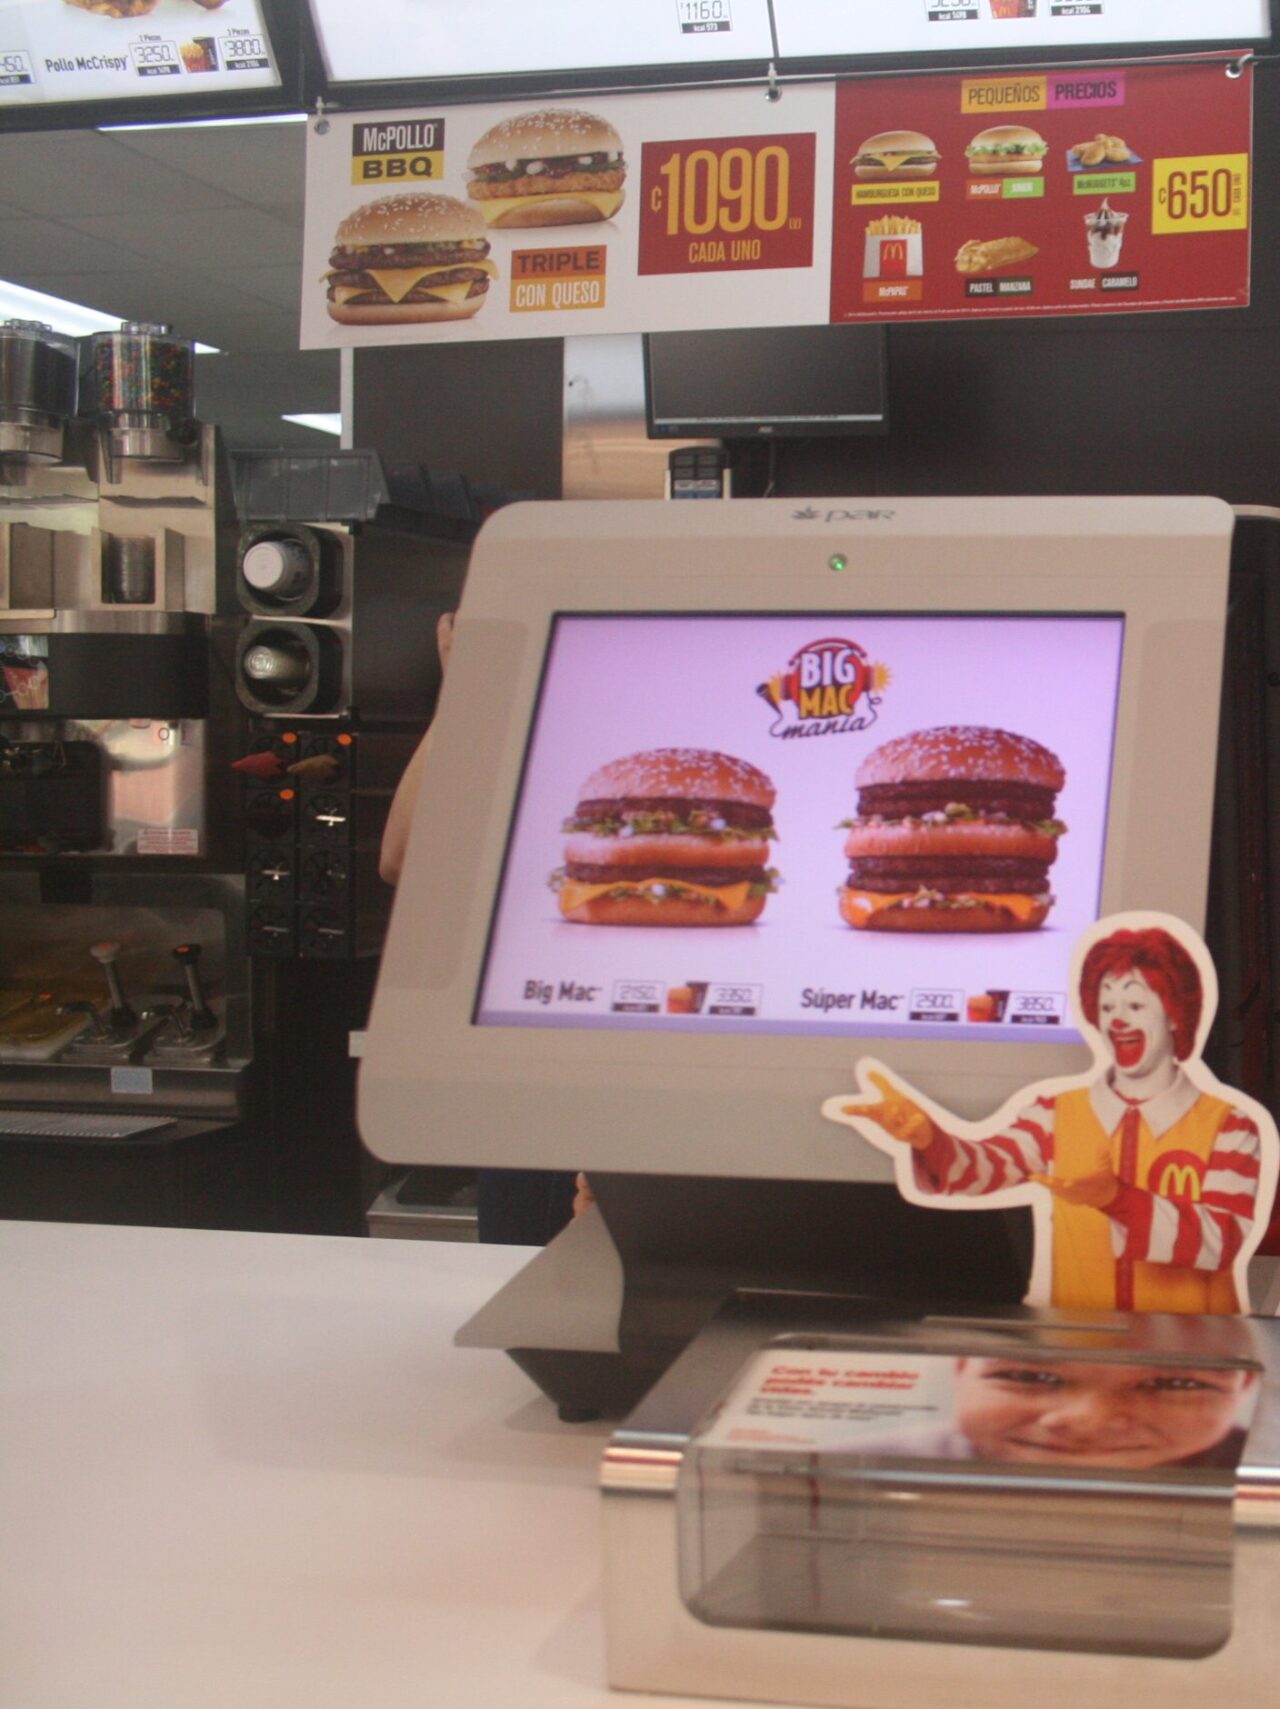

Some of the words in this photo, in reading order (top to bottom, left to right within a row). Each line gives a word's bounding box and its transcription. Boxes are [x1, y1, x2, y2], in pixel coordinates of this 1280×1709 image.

[45, 58, 75, 73] Pollo
[77, 56, 127, 71] McCrispy
[968, 84, 1041, 105] PEQUEÑOS
[1055, 81, 1117, 101] PRECIOS
[363, 123, 435, 152] McPOLLO
[363, 156, 433, 179] BBQ
[517, 250, 600, 273] TRIPLE
[688, 241, 726, 263] CADA
[731, 238, 761, 261] UNO
[515, 283, 547, 307] CON
[551, 280, 600, 308] QUESO
[969, 282, 994, 293] PASTEL
[801, 649, 856, 688] BIG
[801, 684, 854, 718] MAC
[781, 714, 868, 740] mania
[523, 979, 553, 1005] Big
[558, 980, 596, 1002] Mac
[801, 987, 855, 1013] Súper
[860, 989, 898, 1011] Mac
